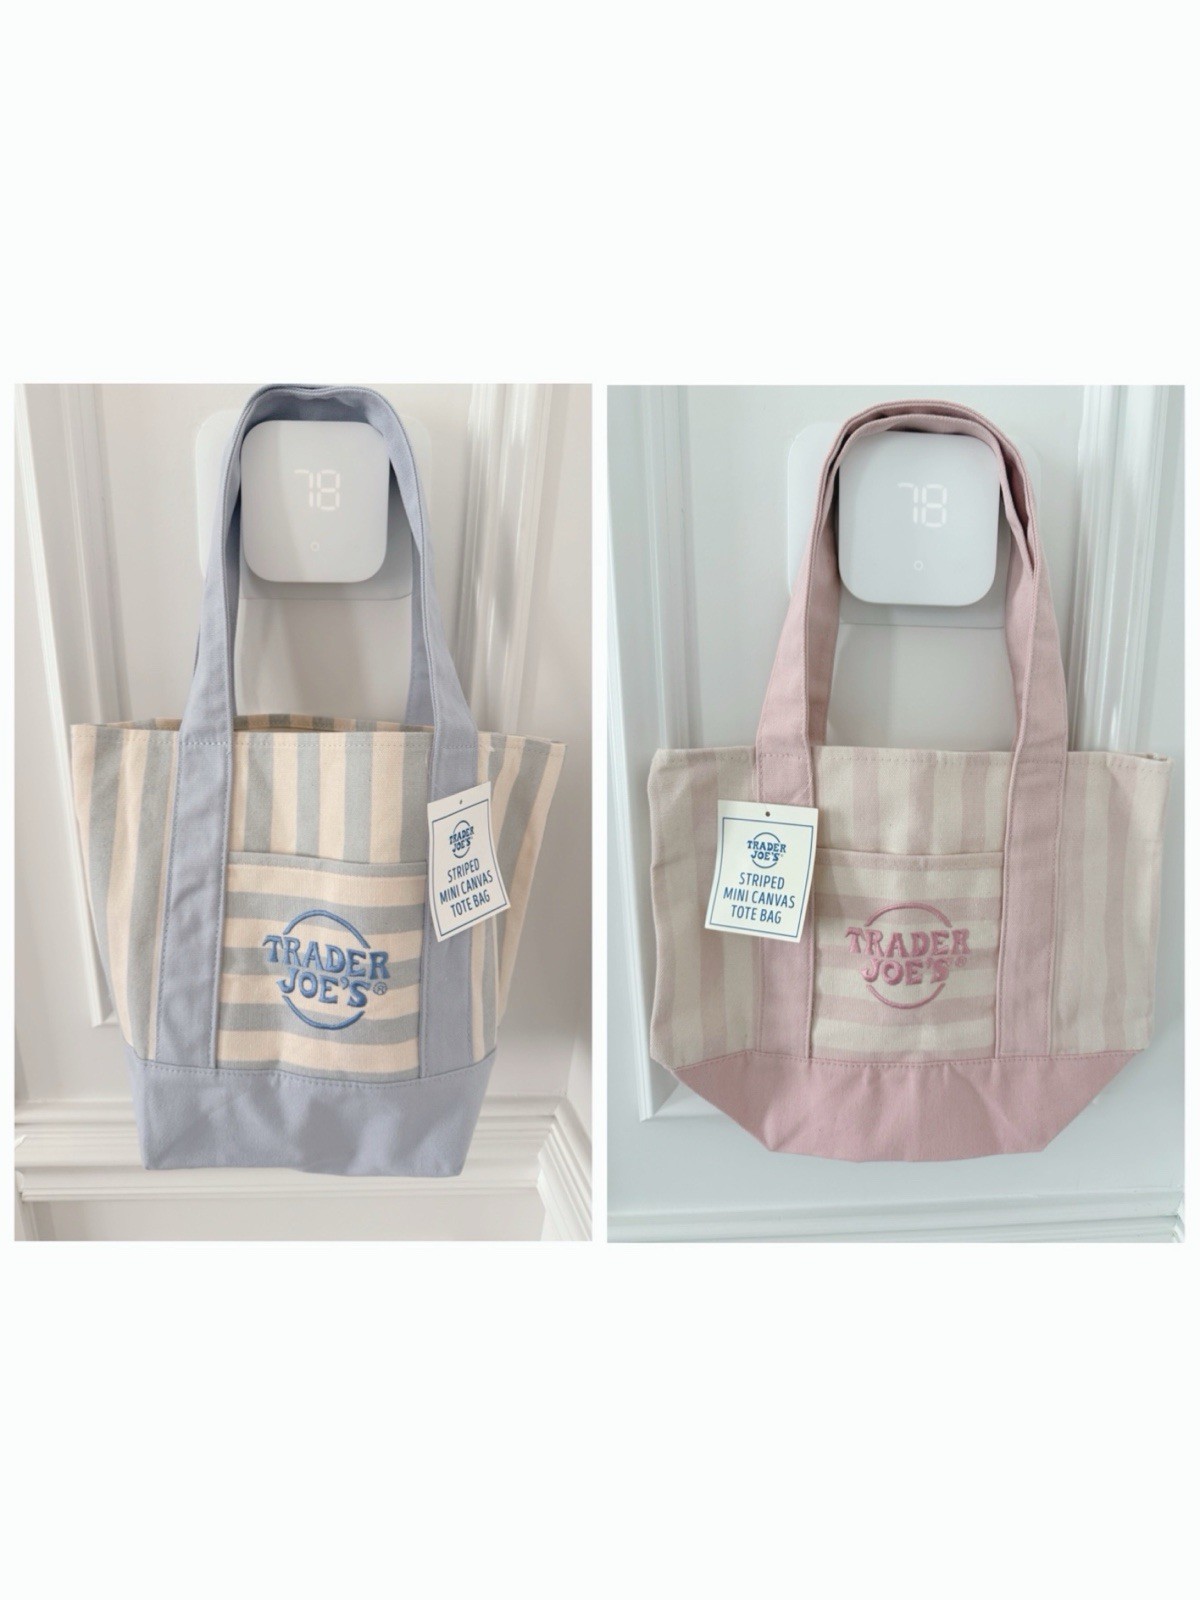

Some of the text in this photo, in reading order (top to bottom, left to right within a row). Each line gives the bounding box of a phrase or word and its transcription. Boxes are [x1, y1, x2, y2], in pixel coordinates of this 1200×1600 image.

[294, 469, 340, 511] 78
[897, 482, 947, 528] 78
[449, 826, 474, 845] TRADER
[452, 836, 471, 853] JOE'S
[746, 840, 786, 853] TRADER
[751, 850, 780, 861] JOE'S
[447, 858, 480, 883] STRIPED
[739, 872, 785, 890] STRIPED
[439, 870, 493, 905] MINI CANVAS
[723, 887, 796, 909] MINI CANVAS
[450, 889, 490, 918] TOTE BAG
[731, 904, 782, 924] TOTE BAG
[845, 927, 970, 958] TRADER
[262, 934, 391, 980] TRADER
